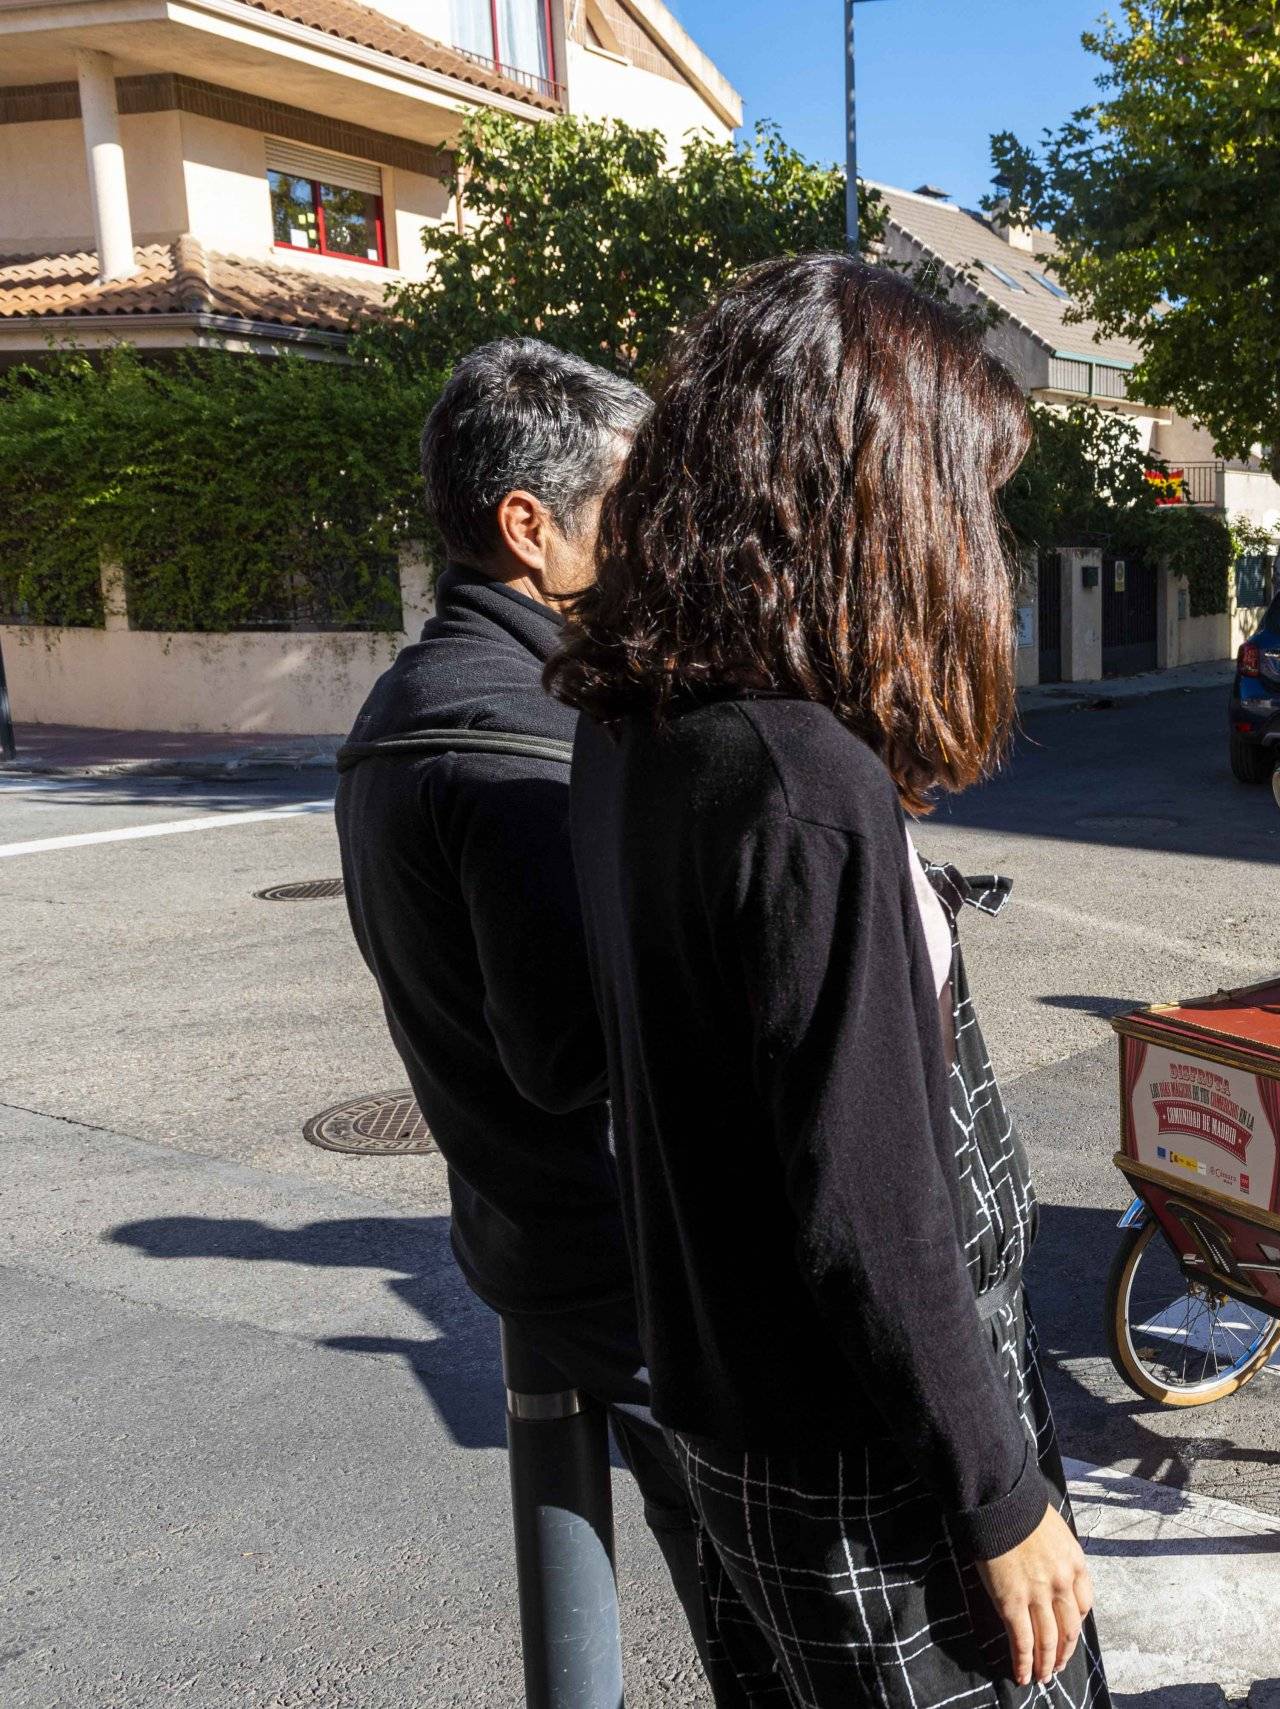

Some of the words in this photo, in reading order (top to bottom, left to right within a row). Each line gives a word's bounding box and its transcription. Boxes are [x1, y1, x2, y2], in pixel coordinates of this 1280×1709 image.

[1169, 1063, 1231, 1097] DISFRUTA
[1166, 1106, 1200, 1128] COMUNIDAD
[1202, 1113, 1211, 1133] DE
[1211, 1117, 1237, 1145] MADRID
